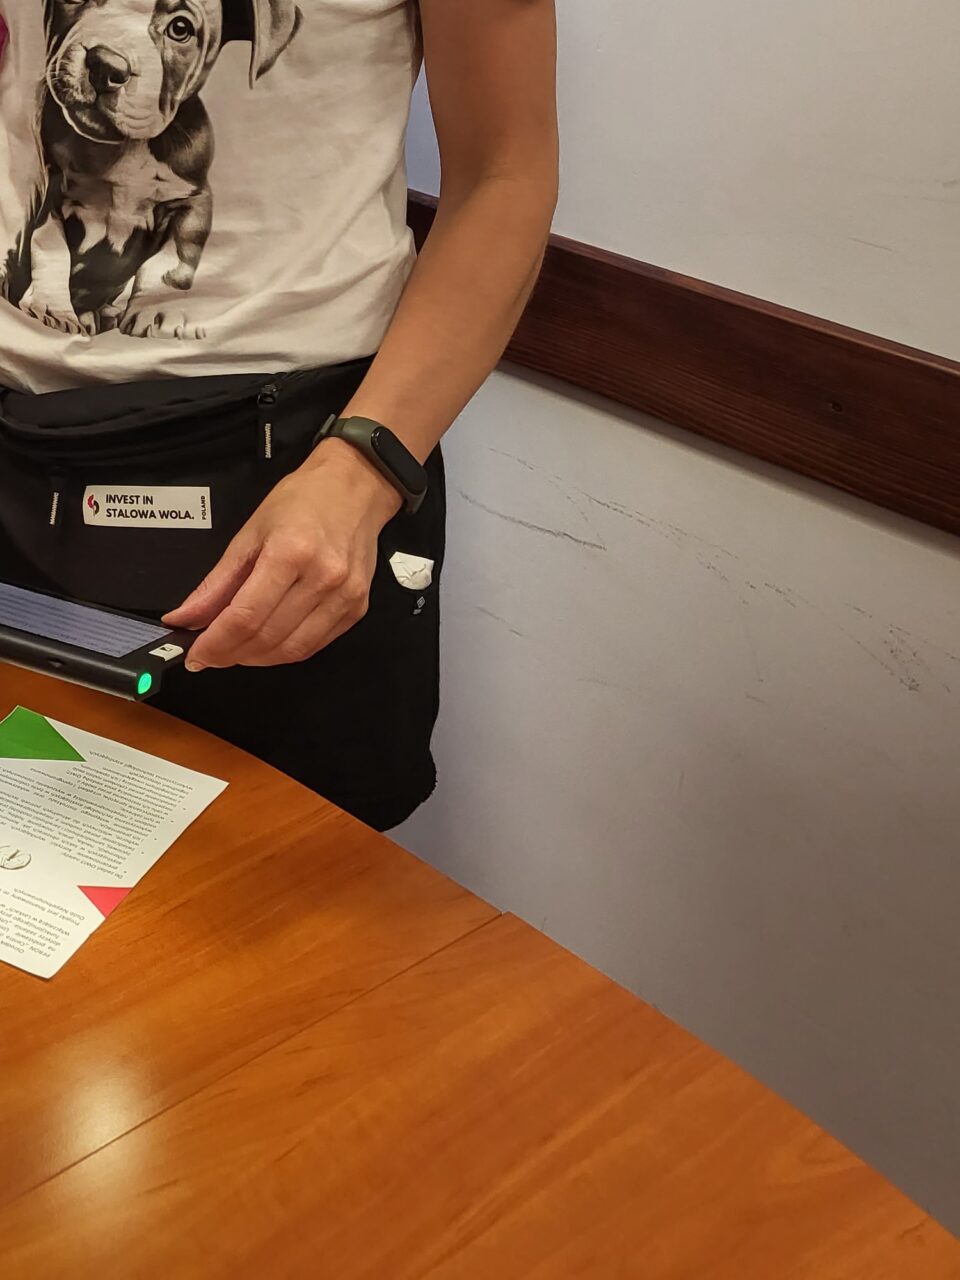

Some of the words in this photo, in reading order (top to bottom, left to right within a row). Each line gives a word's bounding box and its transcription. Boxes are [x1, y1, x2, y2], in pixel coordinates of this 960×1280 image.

[105, 494, 140, 505] INVEST
[142, 496, 153, 505] IN
[105, 508, 157, 519] STALOWA
[159, 510, 195, 520] WOLA.
